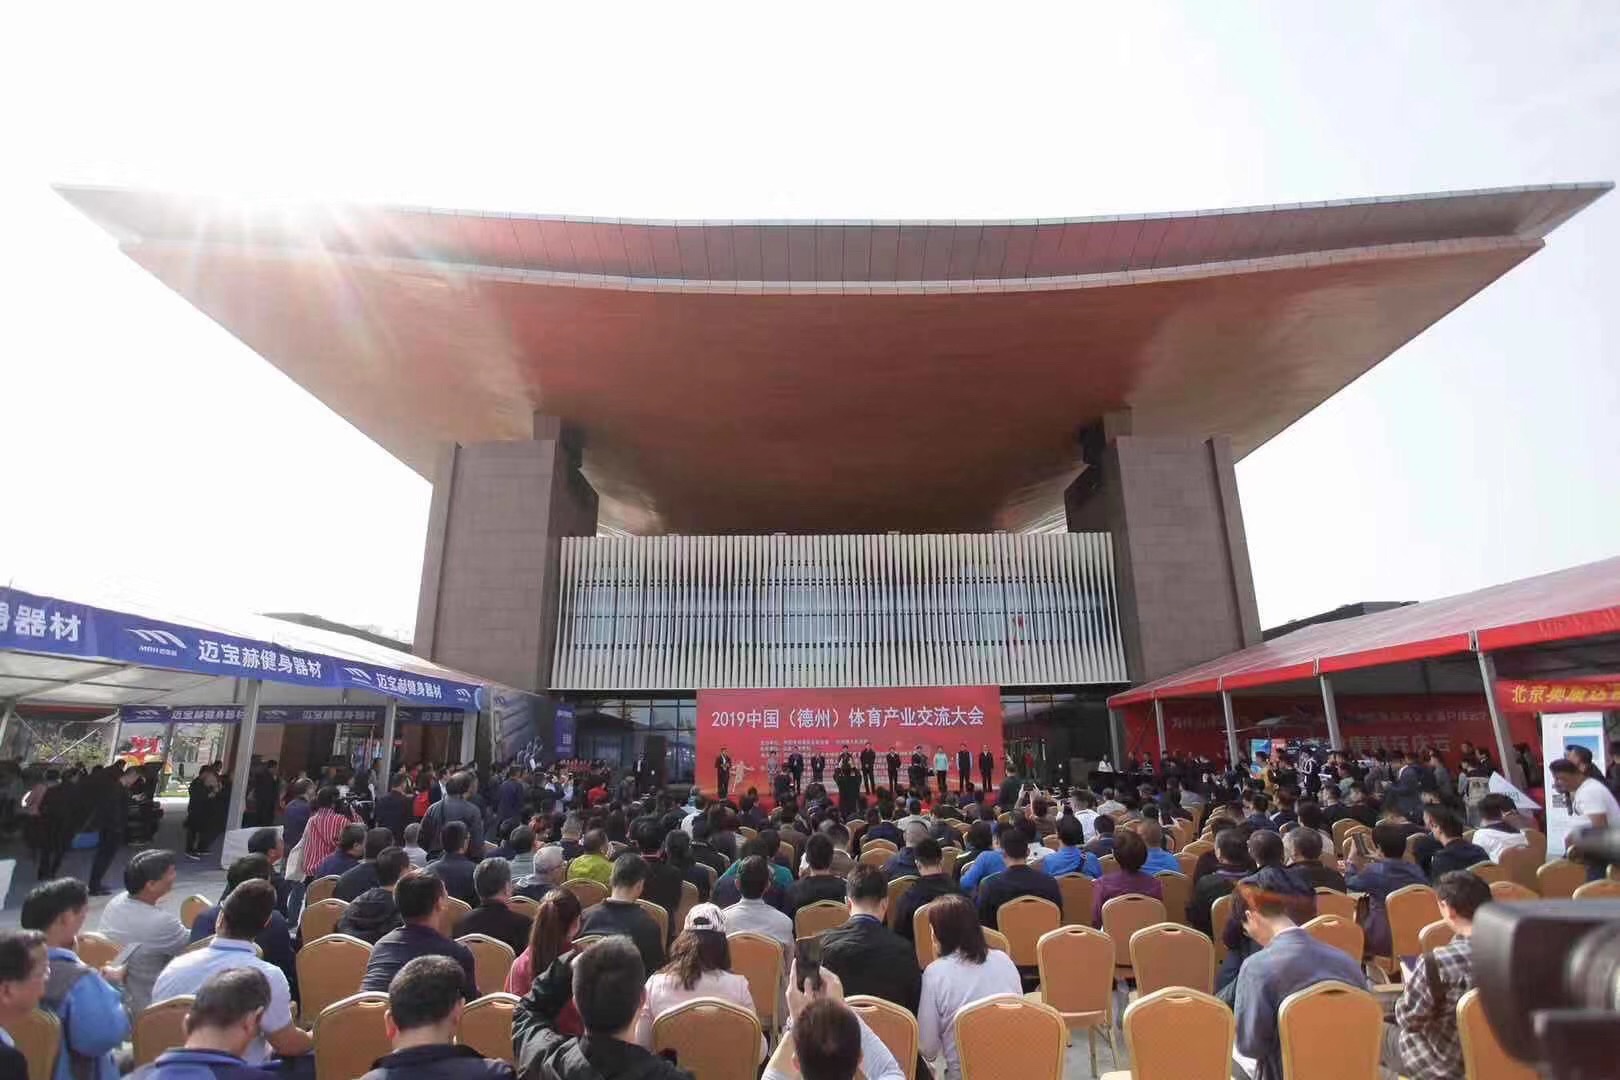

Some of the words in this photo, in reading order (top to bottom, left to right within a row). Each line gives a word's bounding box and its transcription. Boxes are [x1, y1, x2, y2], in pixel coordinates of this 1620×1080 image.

[198, 639, 321, 679] 迈宝赫健身器材
[711, 705, 984, 728] 2019中国（德州）体育产业交流大会
